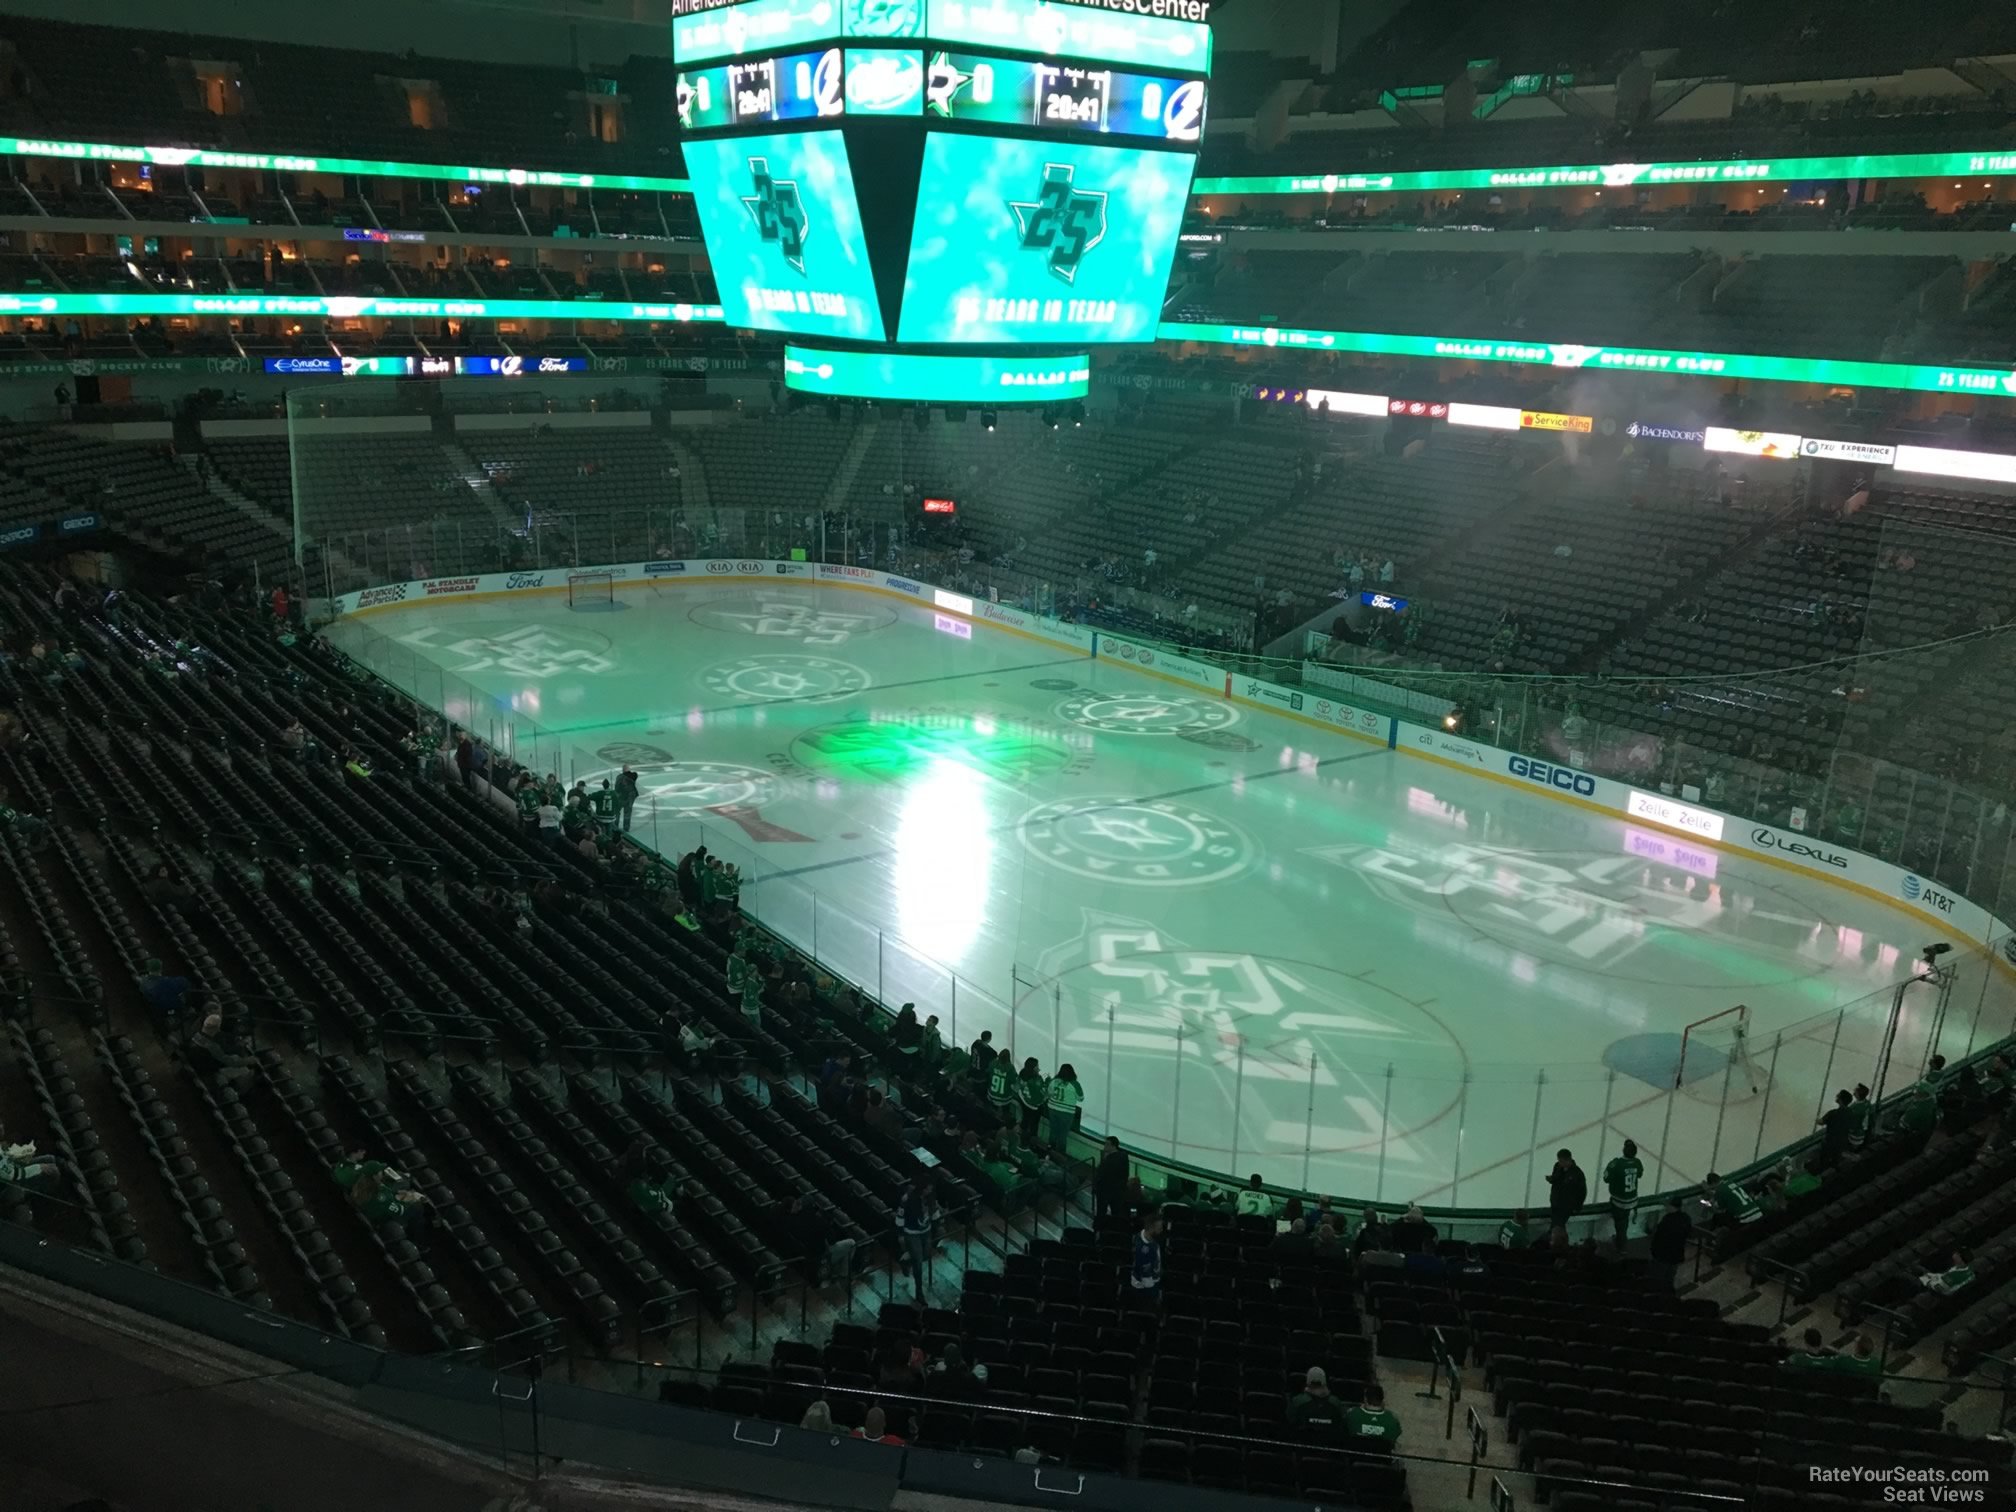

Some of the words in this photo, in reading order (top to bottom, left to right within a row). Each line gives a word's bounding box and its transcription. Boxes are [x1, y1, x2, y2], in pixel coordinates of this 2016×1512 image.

[1046, 93, 1099, 122] 20:41
[1067, 301, 1116, 322] TEXAS
[538, 357, 569, 371] Ford
[1641, 424, 1704, 442] BACHENDORF'S
[1841, 444, 1890, 455] EXPERIENCE
[63, 516, 94, 530] GEICO
[711, 563, 729, 571] KIA
[741, 563, 759, 571] KIA
[506, 571, 545, 590] Ford
[982, 603, 1025, 626] Budweiser
[1508, 755, 1595, 797] GEICO
[1638, 798, 1670, 818] Zelle
[1679, 811, 1712, 831] Zelle
[1777, 837, 1848, 869] LEXUS
[1922, 888, 1956, 914] AT&T
[991, 1074, 1005, 1095] 91
